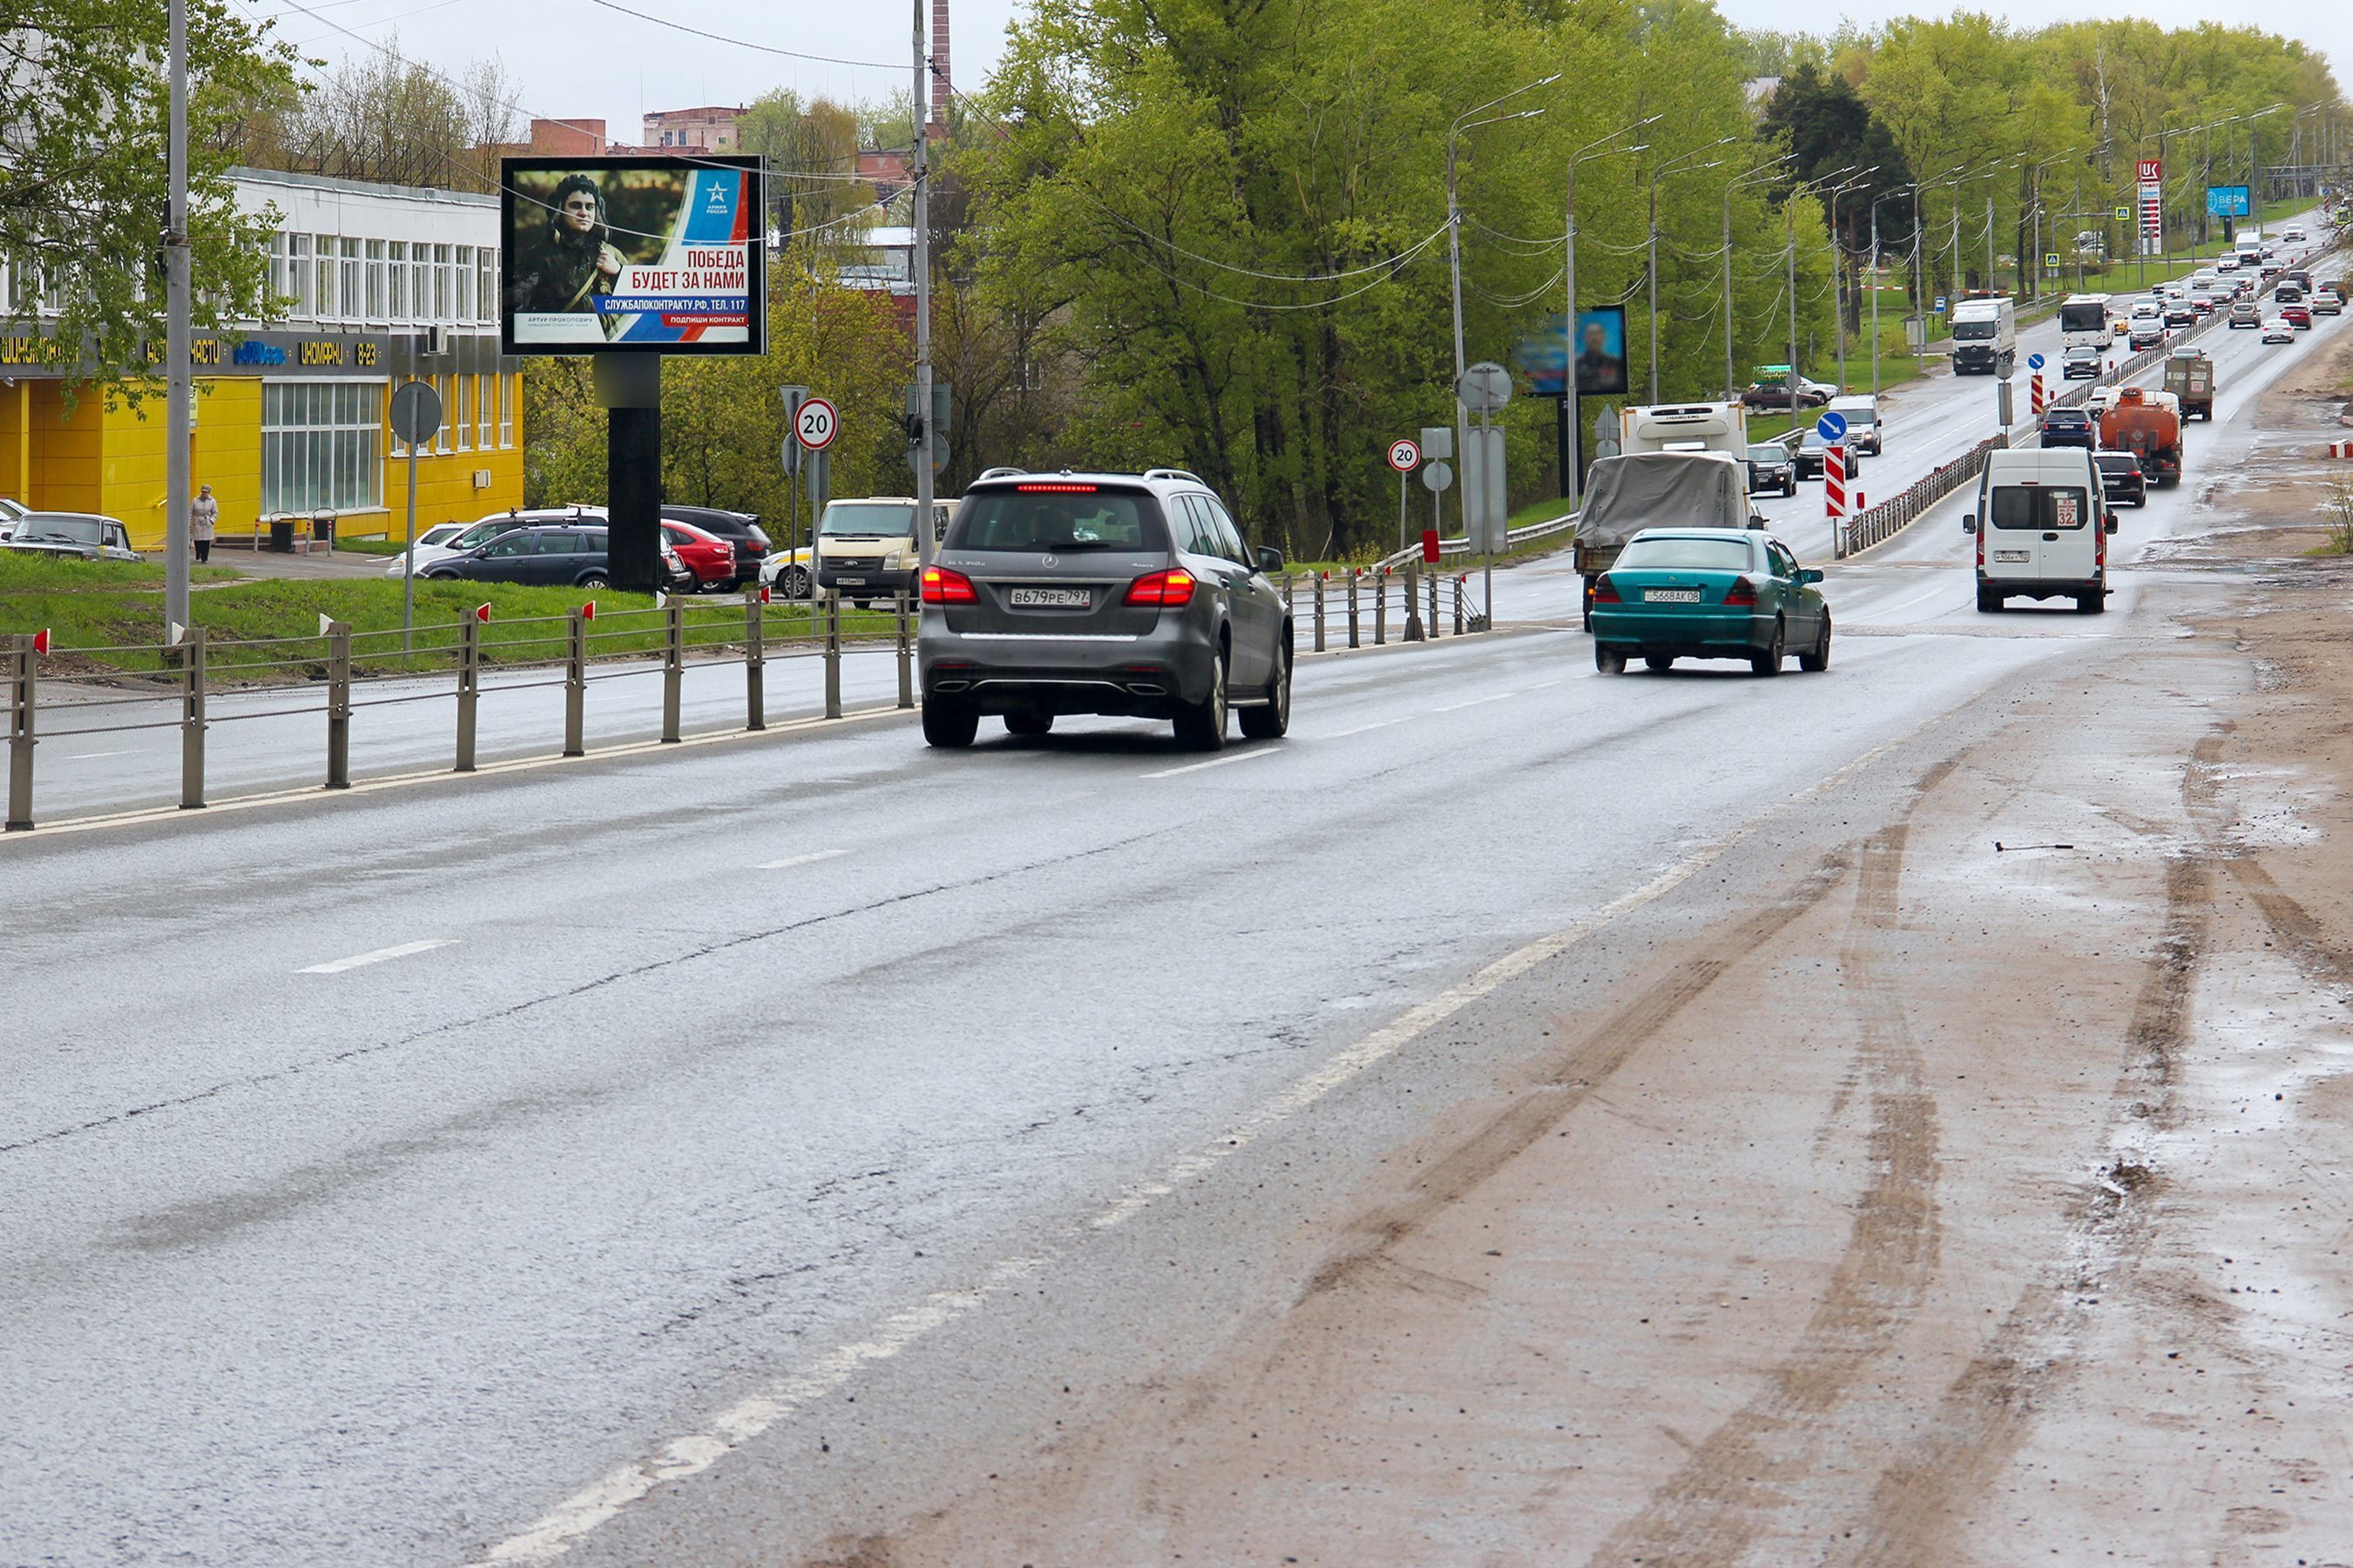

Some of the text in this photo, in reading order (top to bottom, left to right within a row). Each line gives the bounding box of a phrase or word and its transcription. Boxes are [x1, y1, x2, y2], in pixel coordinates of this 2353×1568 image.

[2218, 195, 2247, 204] ВЕРА
[687, 250, 745, 270] ПОБЕДА
[632, 272, 745, 291] БУДЕТ ЗА НАМИ
[605, 299, 746, 311] СЛУЖБАПОКОНТРАКТУ.РФ, ТЕЛ. 117
[301, 341, 343, 365] ИНОМАРКИ
[357, 343, 376, 366] 8-23
[803, 415, 828, 434] 20
[1396, 449, 1413, 462] 20
